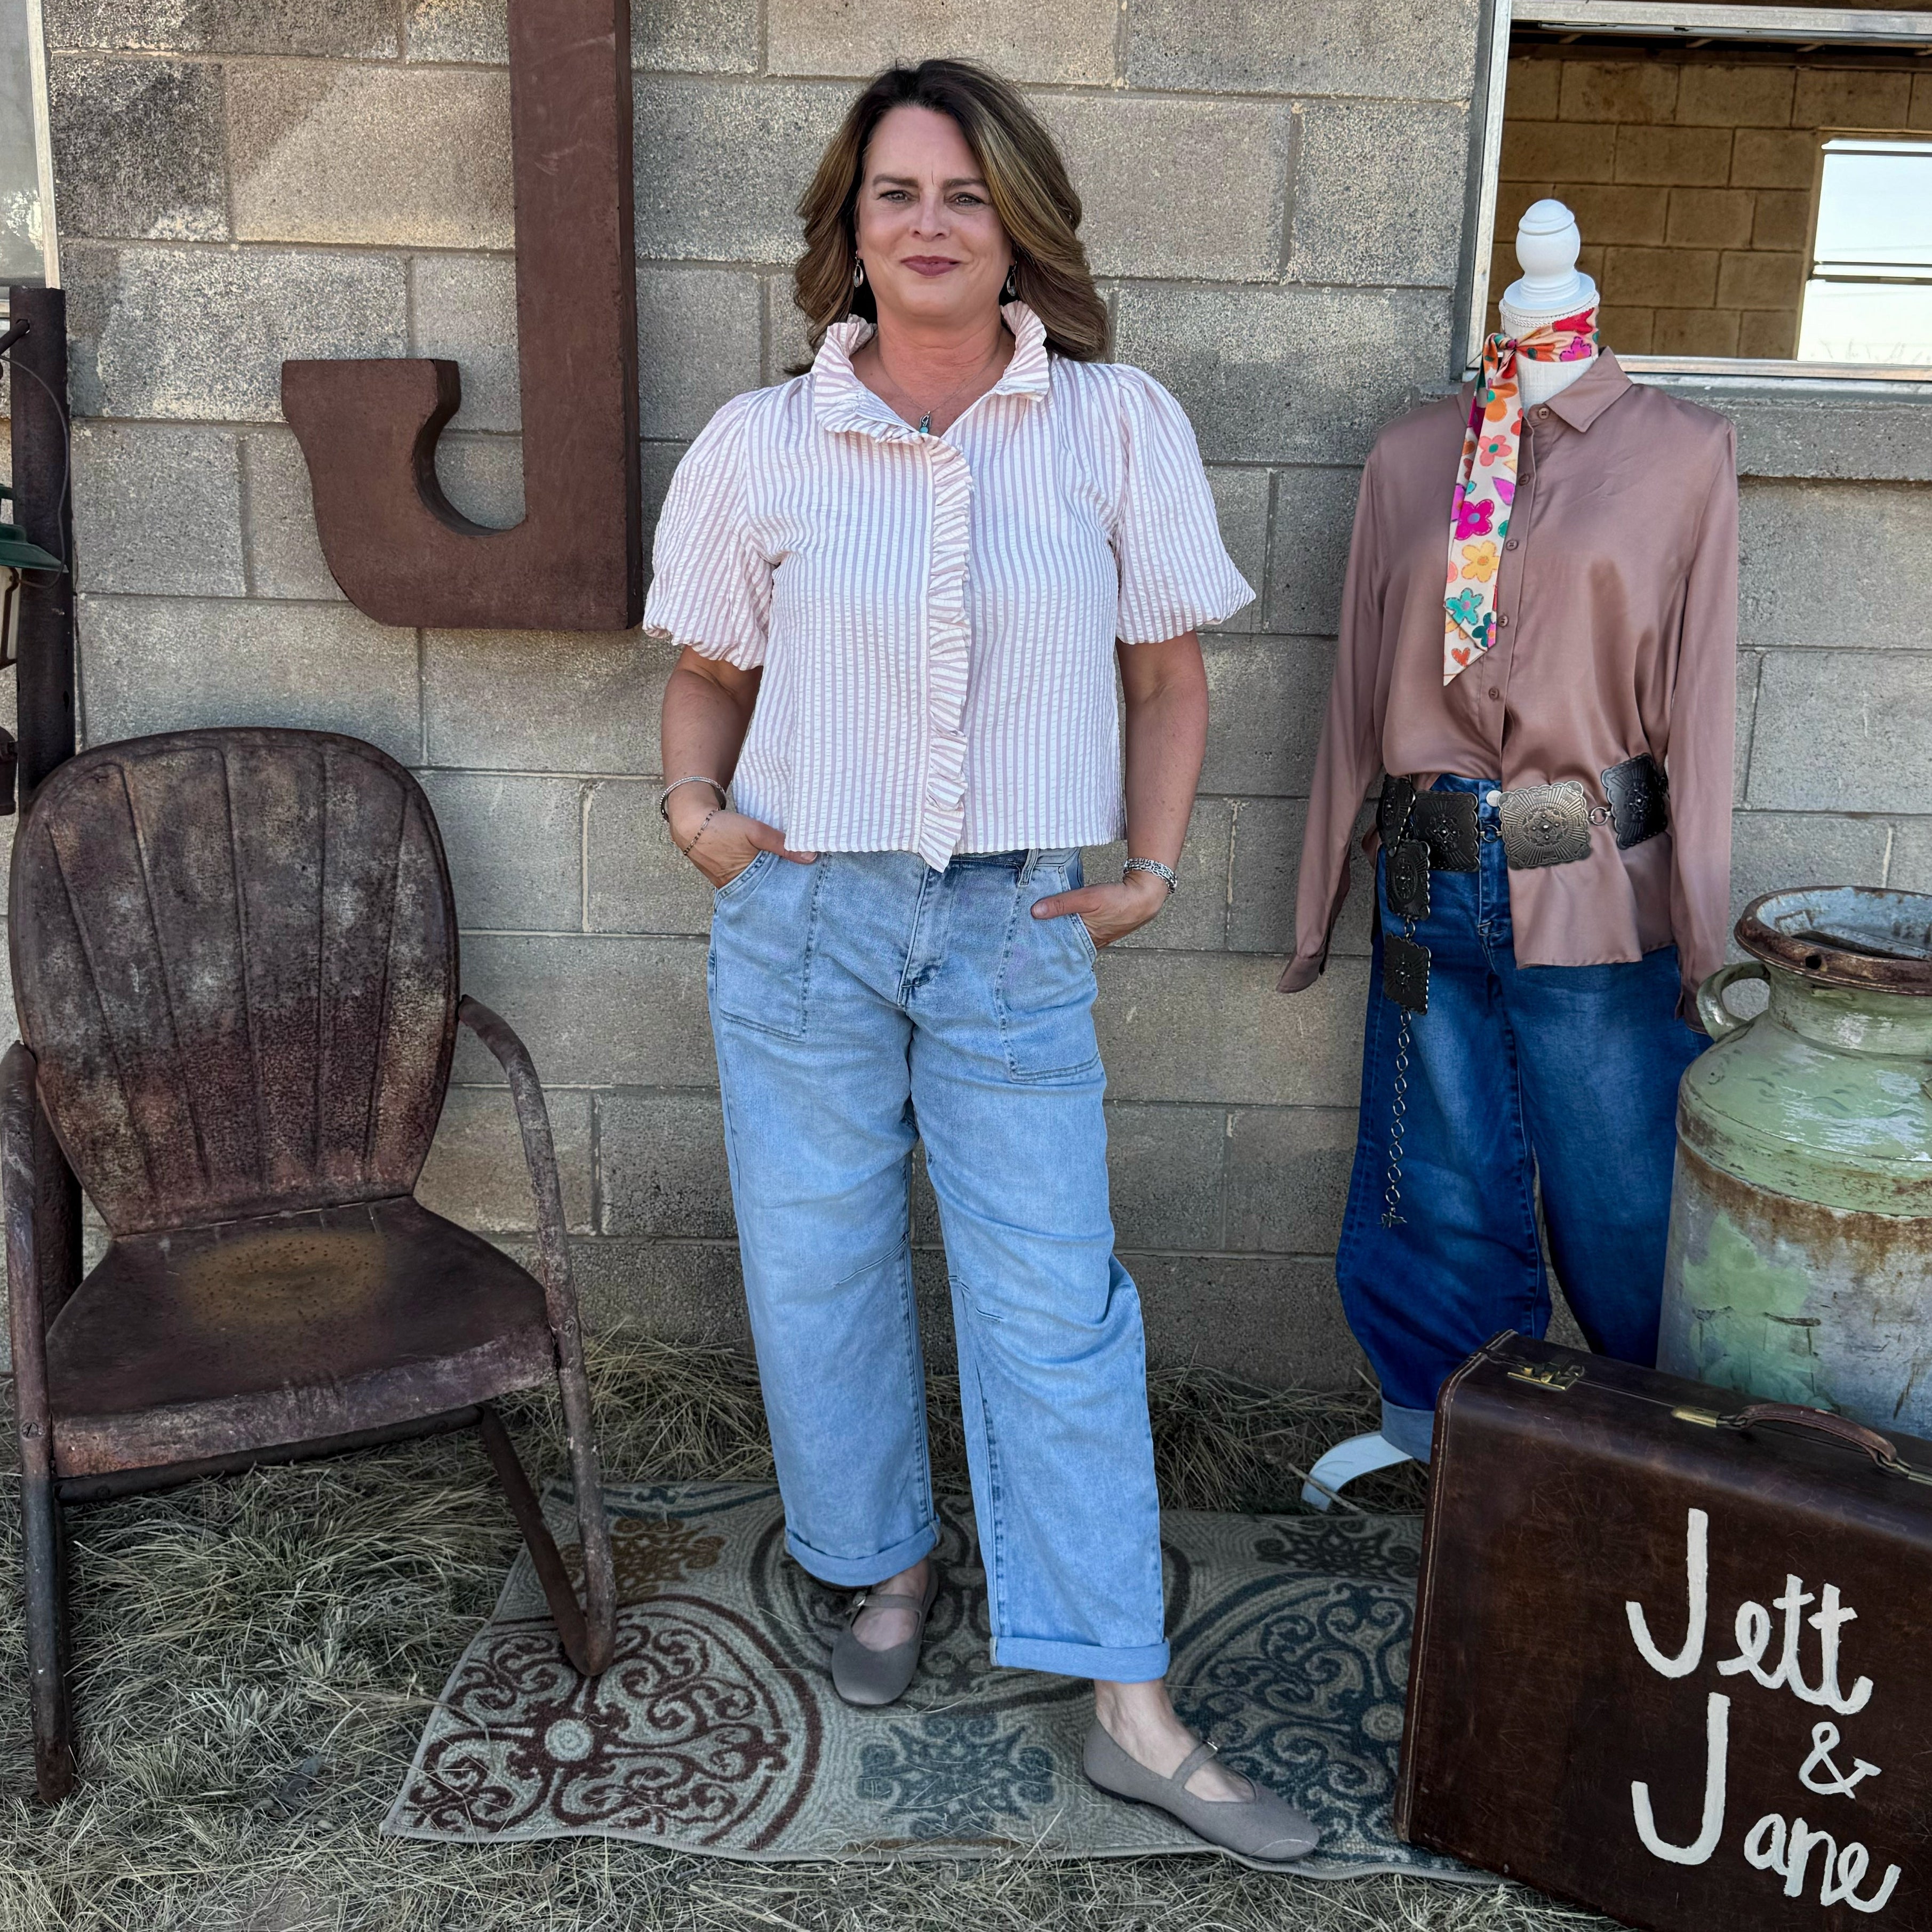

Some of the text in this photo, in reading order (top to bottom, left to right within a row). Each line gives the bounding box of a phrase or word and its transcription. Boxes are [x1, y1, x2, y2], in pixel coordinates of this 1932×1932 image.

[282, 0, 643, 631] J
[1625, 1507, 1874, 1715] Jett
[1631, 1691, 1902, 1913] Jane
[1799, 1721, 1882, 1799] &
